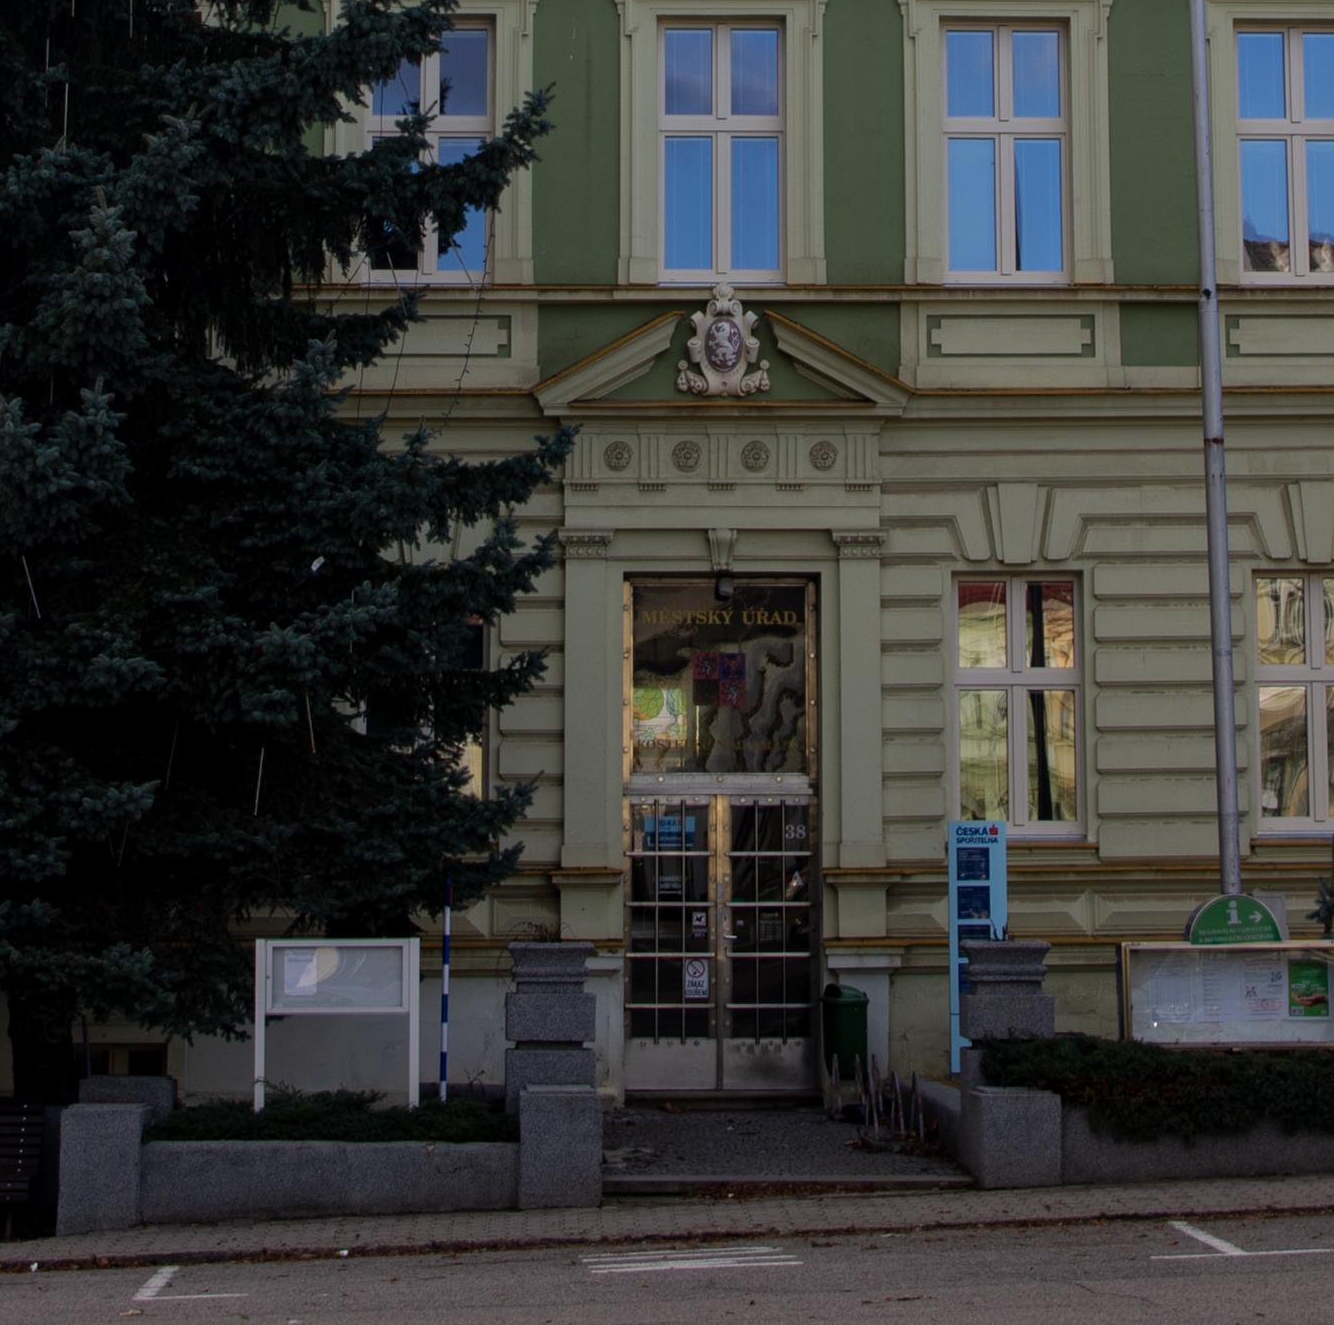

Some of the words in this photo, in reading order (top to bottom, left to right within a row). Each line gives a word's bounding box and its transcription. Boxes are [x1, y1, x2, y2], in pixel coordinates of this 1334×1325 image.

[642, 607, 733, 625] MĚSTSKÝ
[742, 606, 797, 625] ÚŘAD
[785, 825, 806, 839] 38
